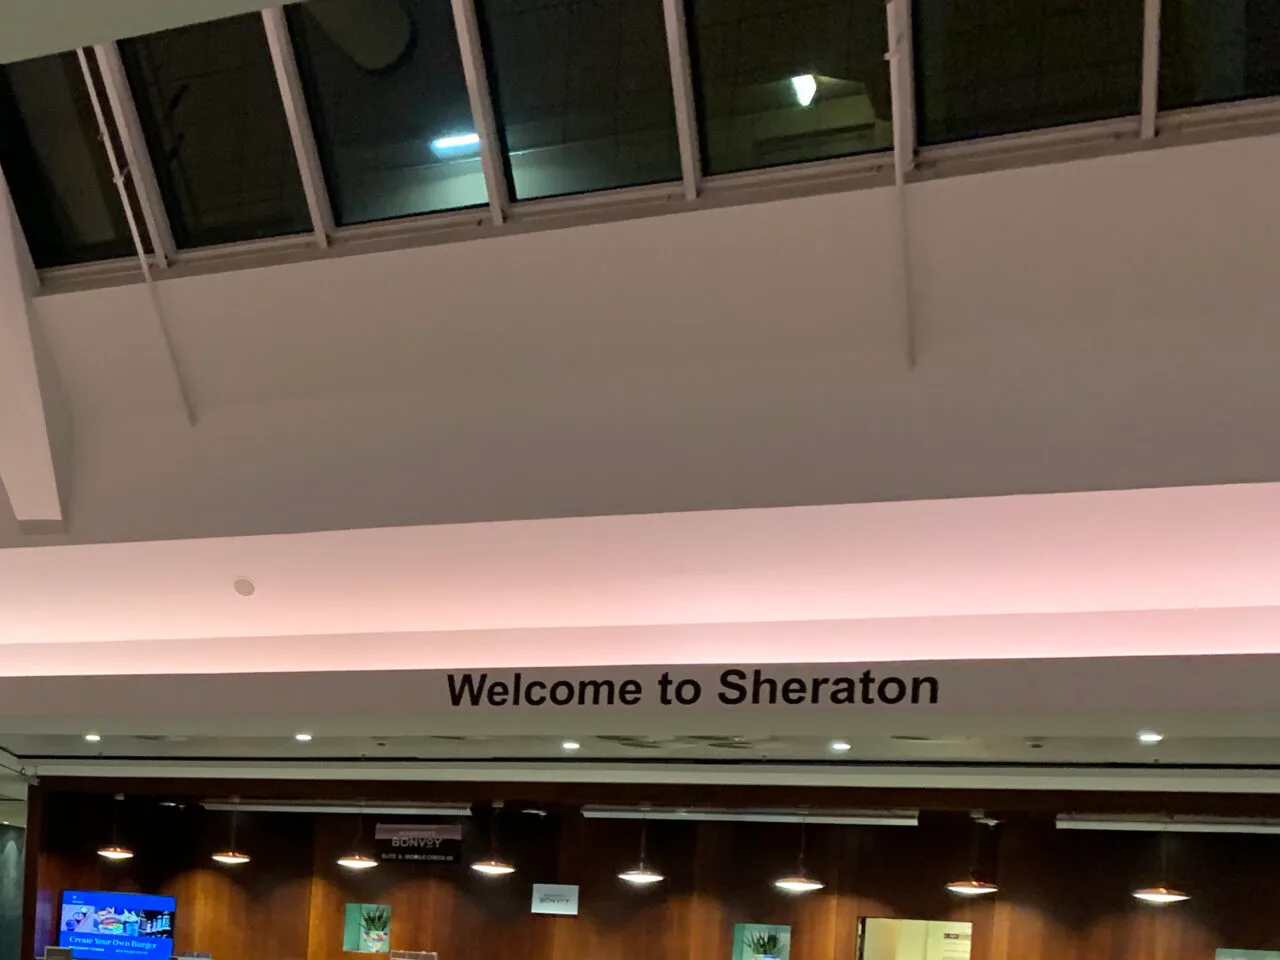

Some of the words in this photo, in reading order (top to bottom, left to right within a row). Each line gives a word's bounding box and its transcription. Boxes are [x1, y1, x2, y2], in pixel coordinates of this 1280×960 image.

[447, 672, 642, 707] Welcome
[658, 671, 702, 706] to
[717, 668, 939, 706] Sheraton
[391, 836, 442, 848] BONVOY
[69, 935, 94, 945] Create
[94, 937, 112, 946] Your
[112, 939, 130, 948] Own
[131, 940, 158, 950] Burger
